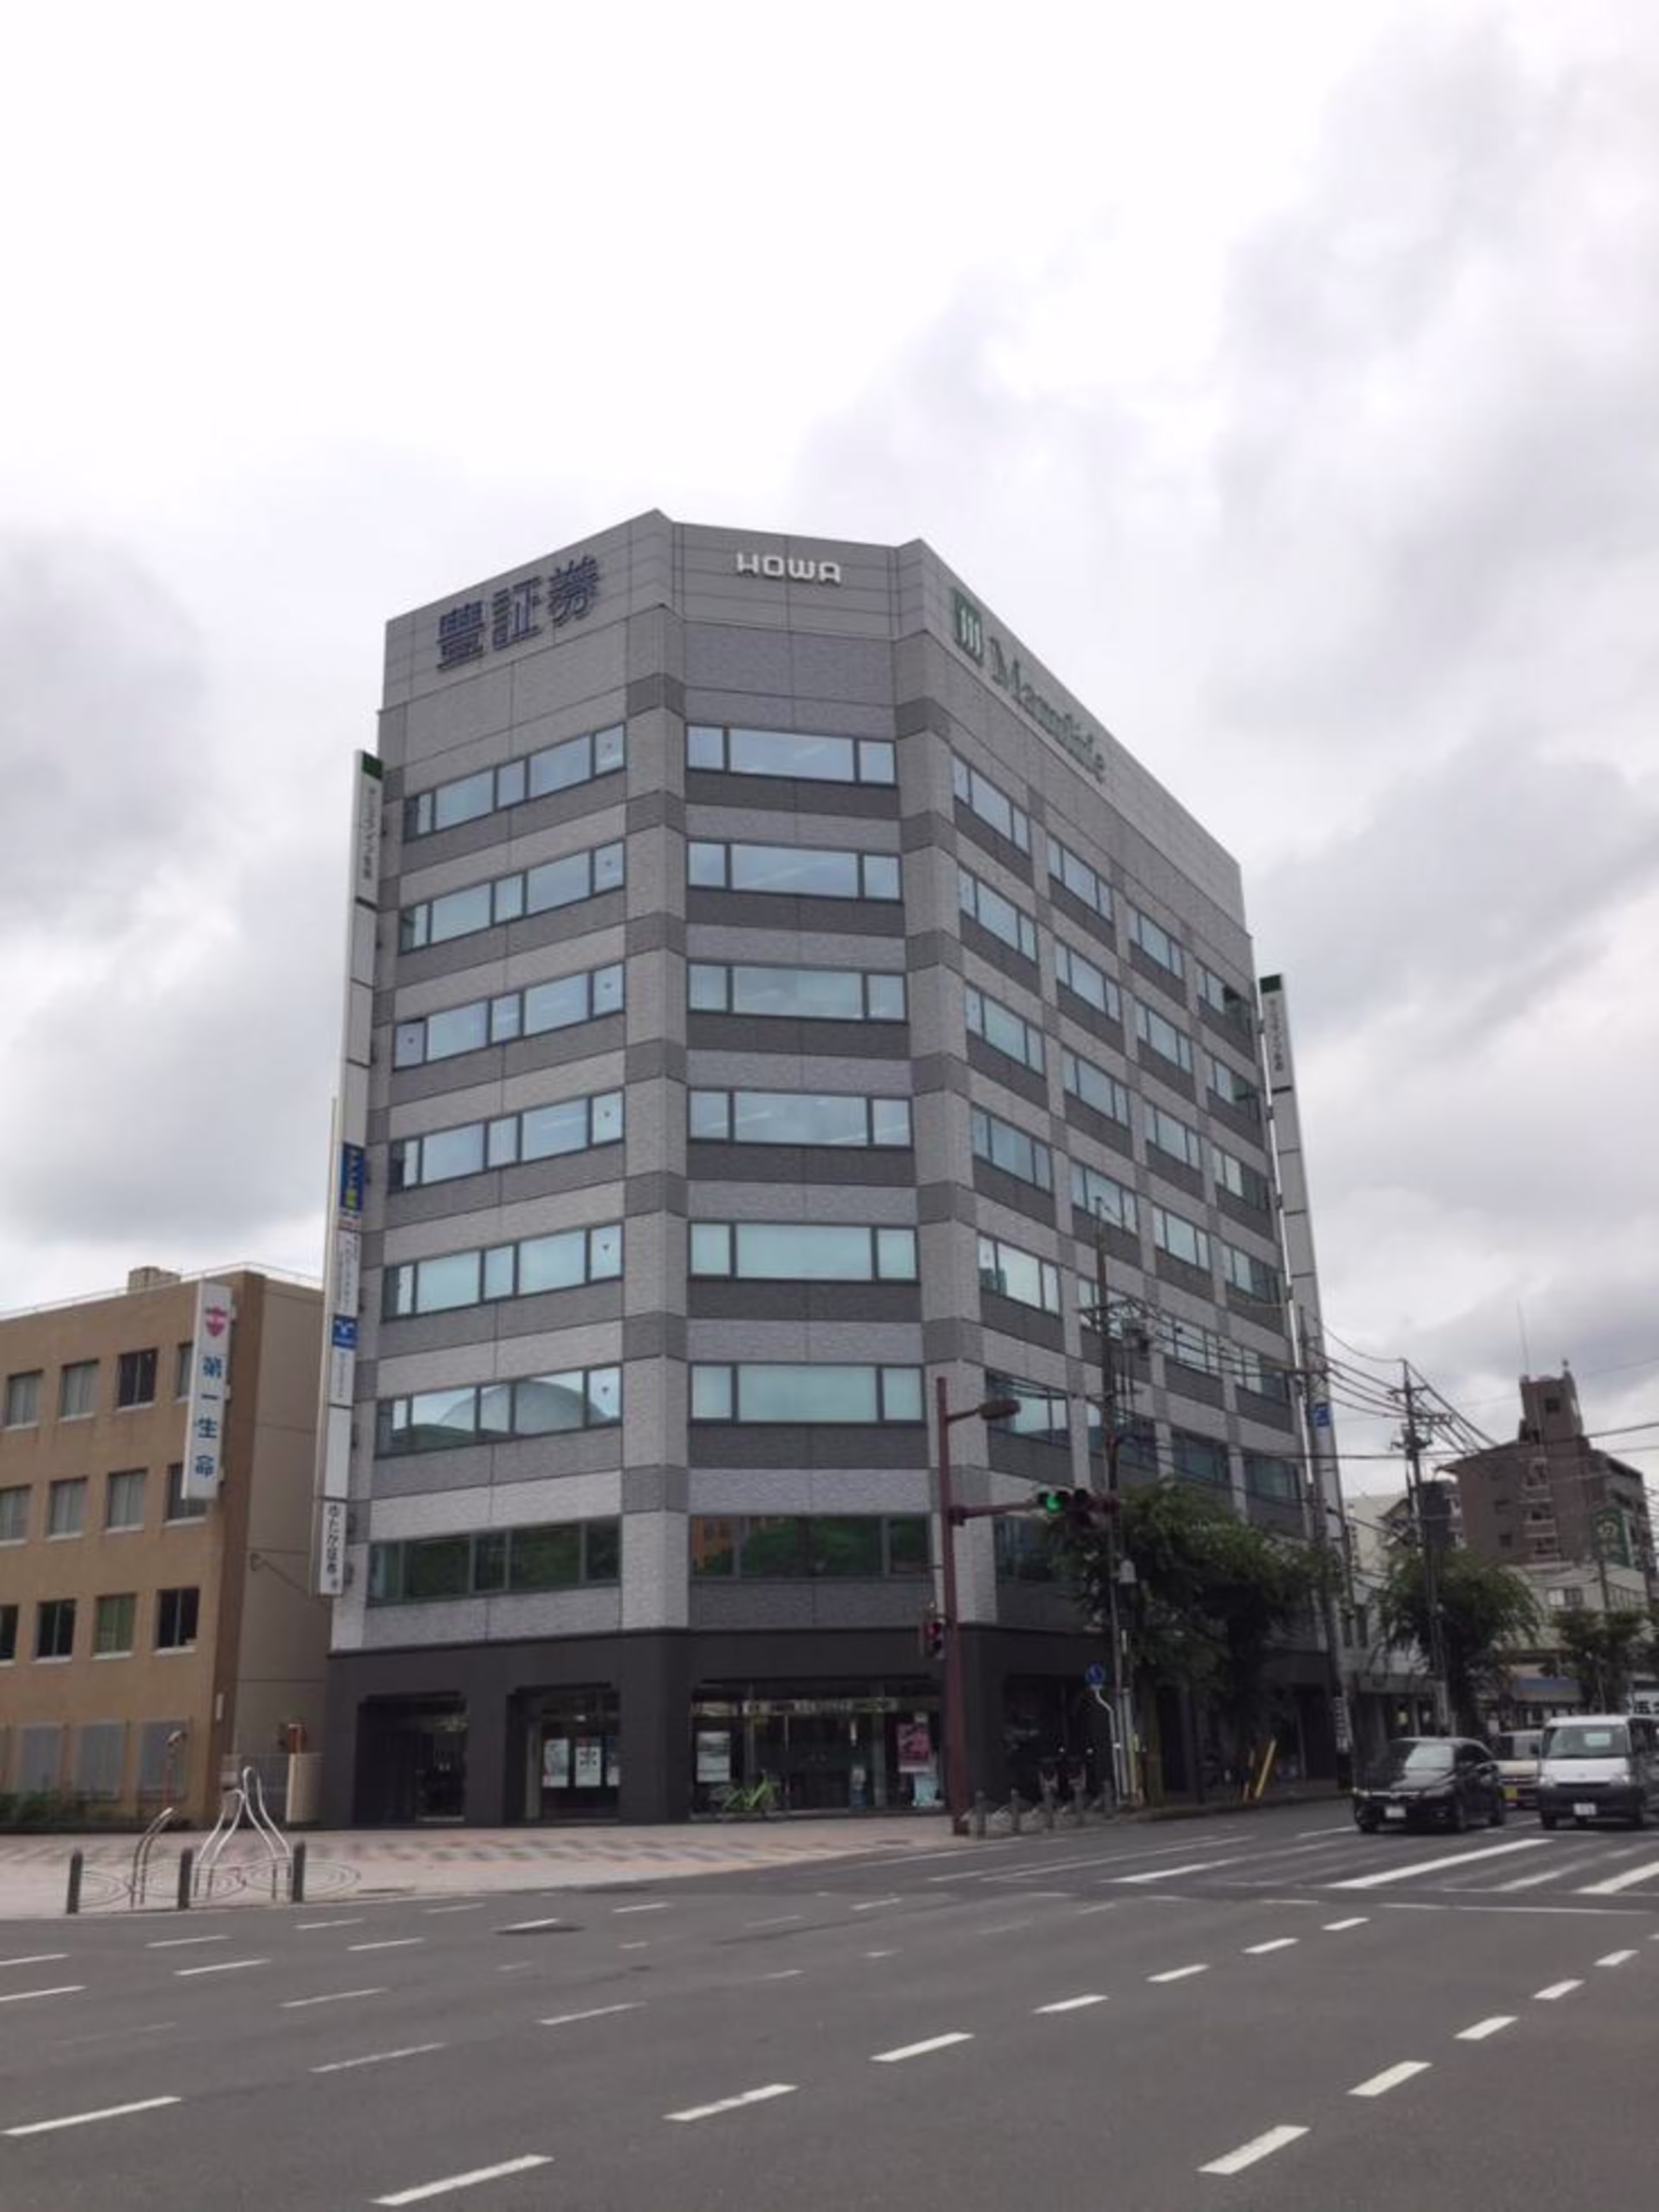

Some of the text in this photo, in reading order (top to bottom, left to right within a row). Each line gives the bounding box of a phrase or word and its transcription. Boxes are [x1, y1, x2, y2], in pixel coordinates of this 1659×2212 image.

[737, 552, 841, 583] HOWA
[436, 555, 601, 669] 豊証券
